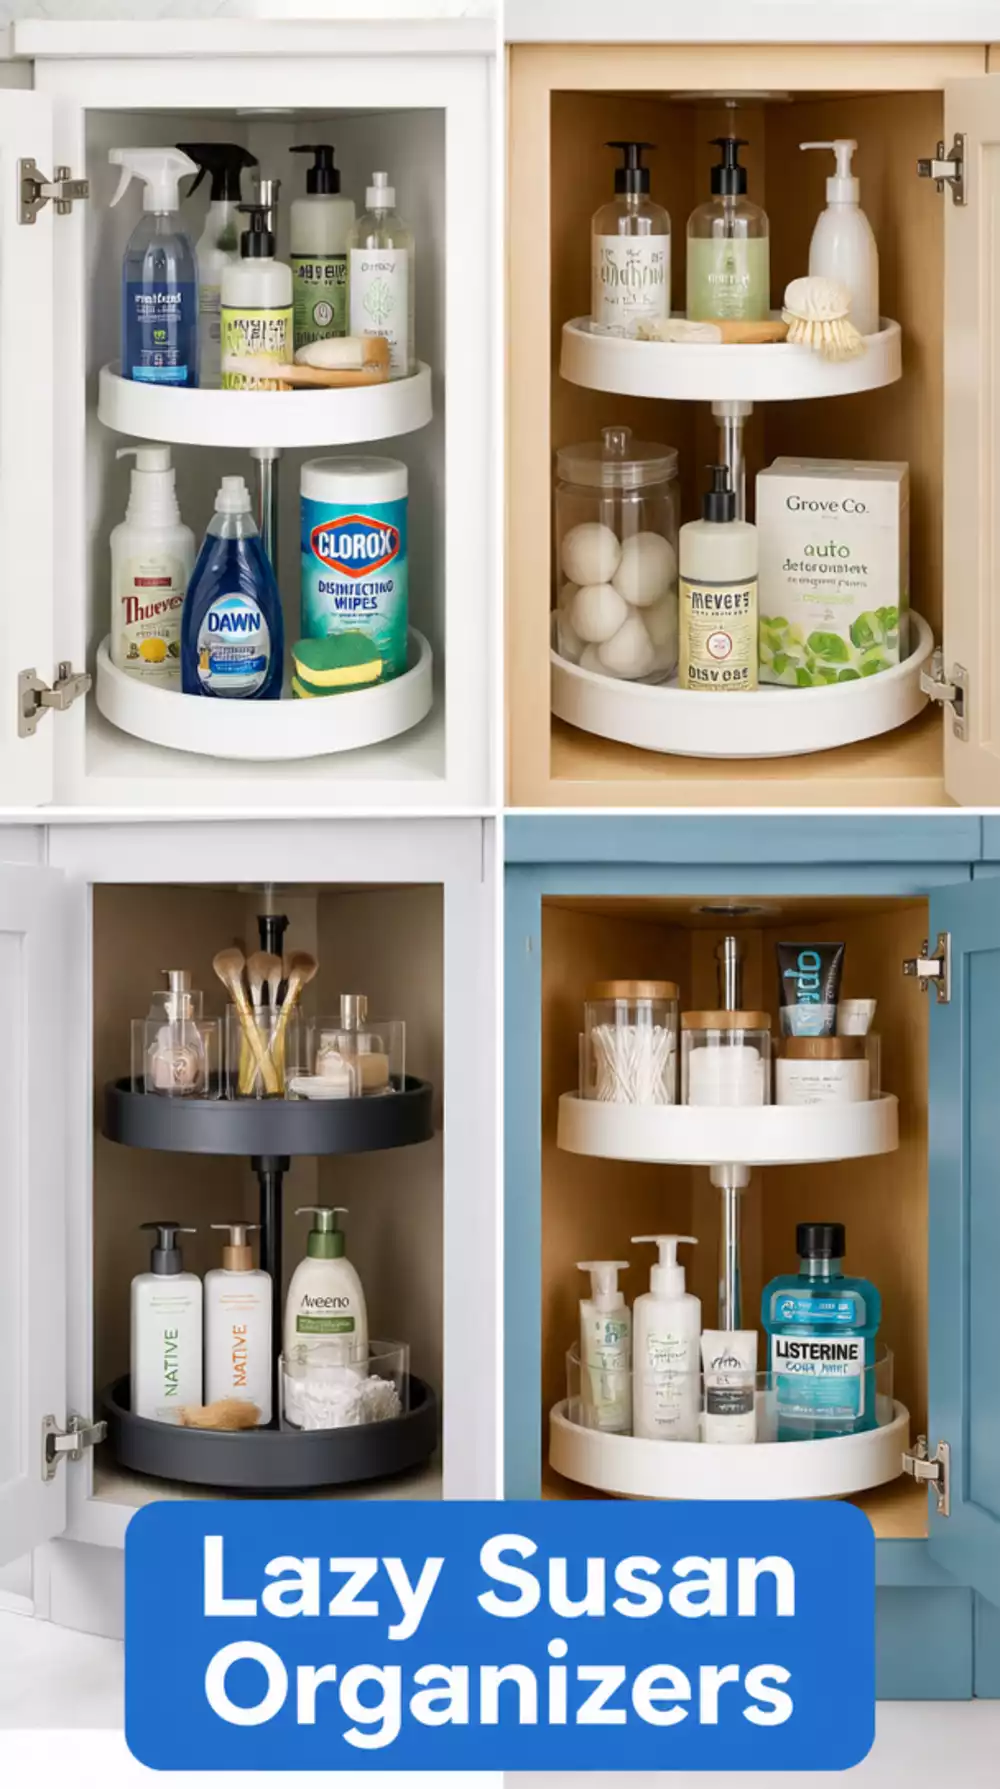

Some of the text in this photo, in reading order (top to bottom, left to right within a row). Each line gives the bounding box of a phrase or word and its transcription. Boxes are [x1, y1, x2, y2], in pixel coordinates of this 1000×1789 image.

[785, 495, 870, 515] Grove Co.
[318, 528, 393, 560] CLOROX
[803, 540, 851, 558] auto
[334, 597, 378, 610] WIPES
[208, 612, 261, 632] DAWN
[231, 1324, 248, 1387] NATIVE
[775, 1339, 859, 1360] LISTERINE
[164, 1328, 179, 1397] NATIVE
